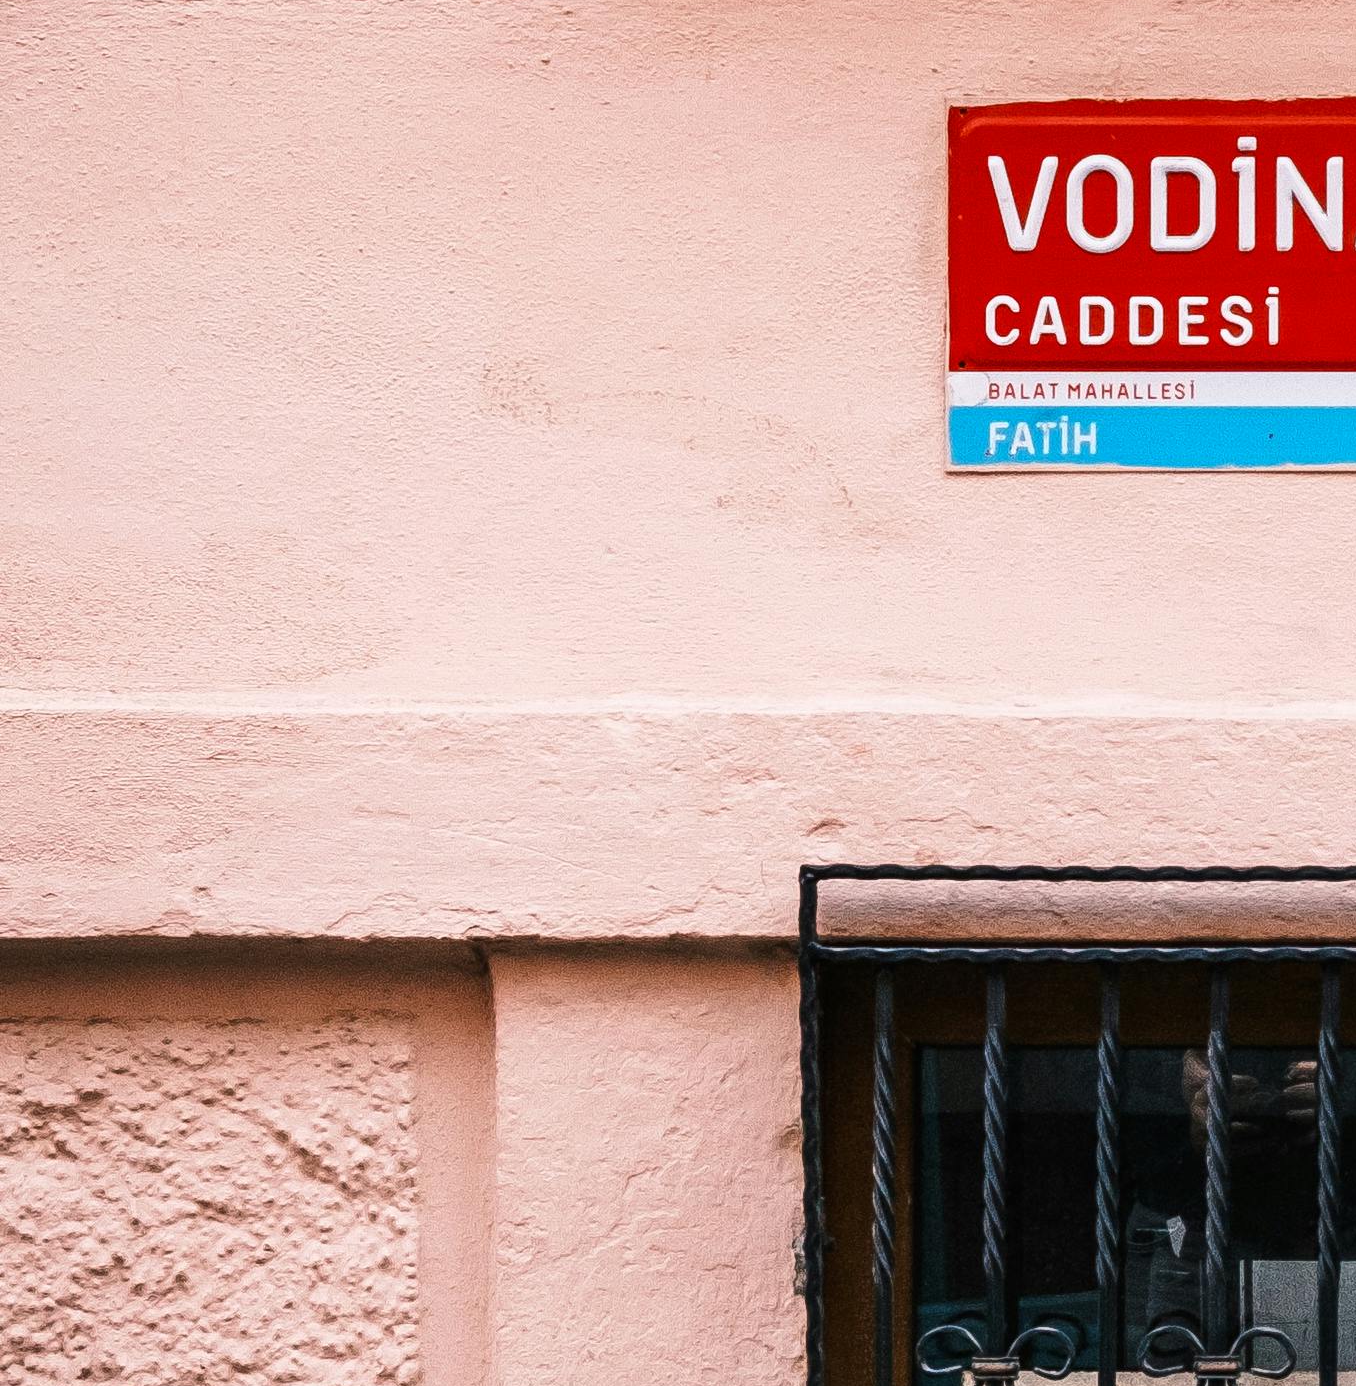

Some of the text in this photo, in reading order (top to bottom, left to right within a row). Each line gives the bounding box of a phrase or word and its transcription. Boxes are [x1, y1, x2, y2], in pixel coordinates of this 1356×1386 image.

[985, 286, 1280, 347] CADDESİ
[988, 382, 1059, 400] BALAT
[987, 415, 1097, 455] FATİH
